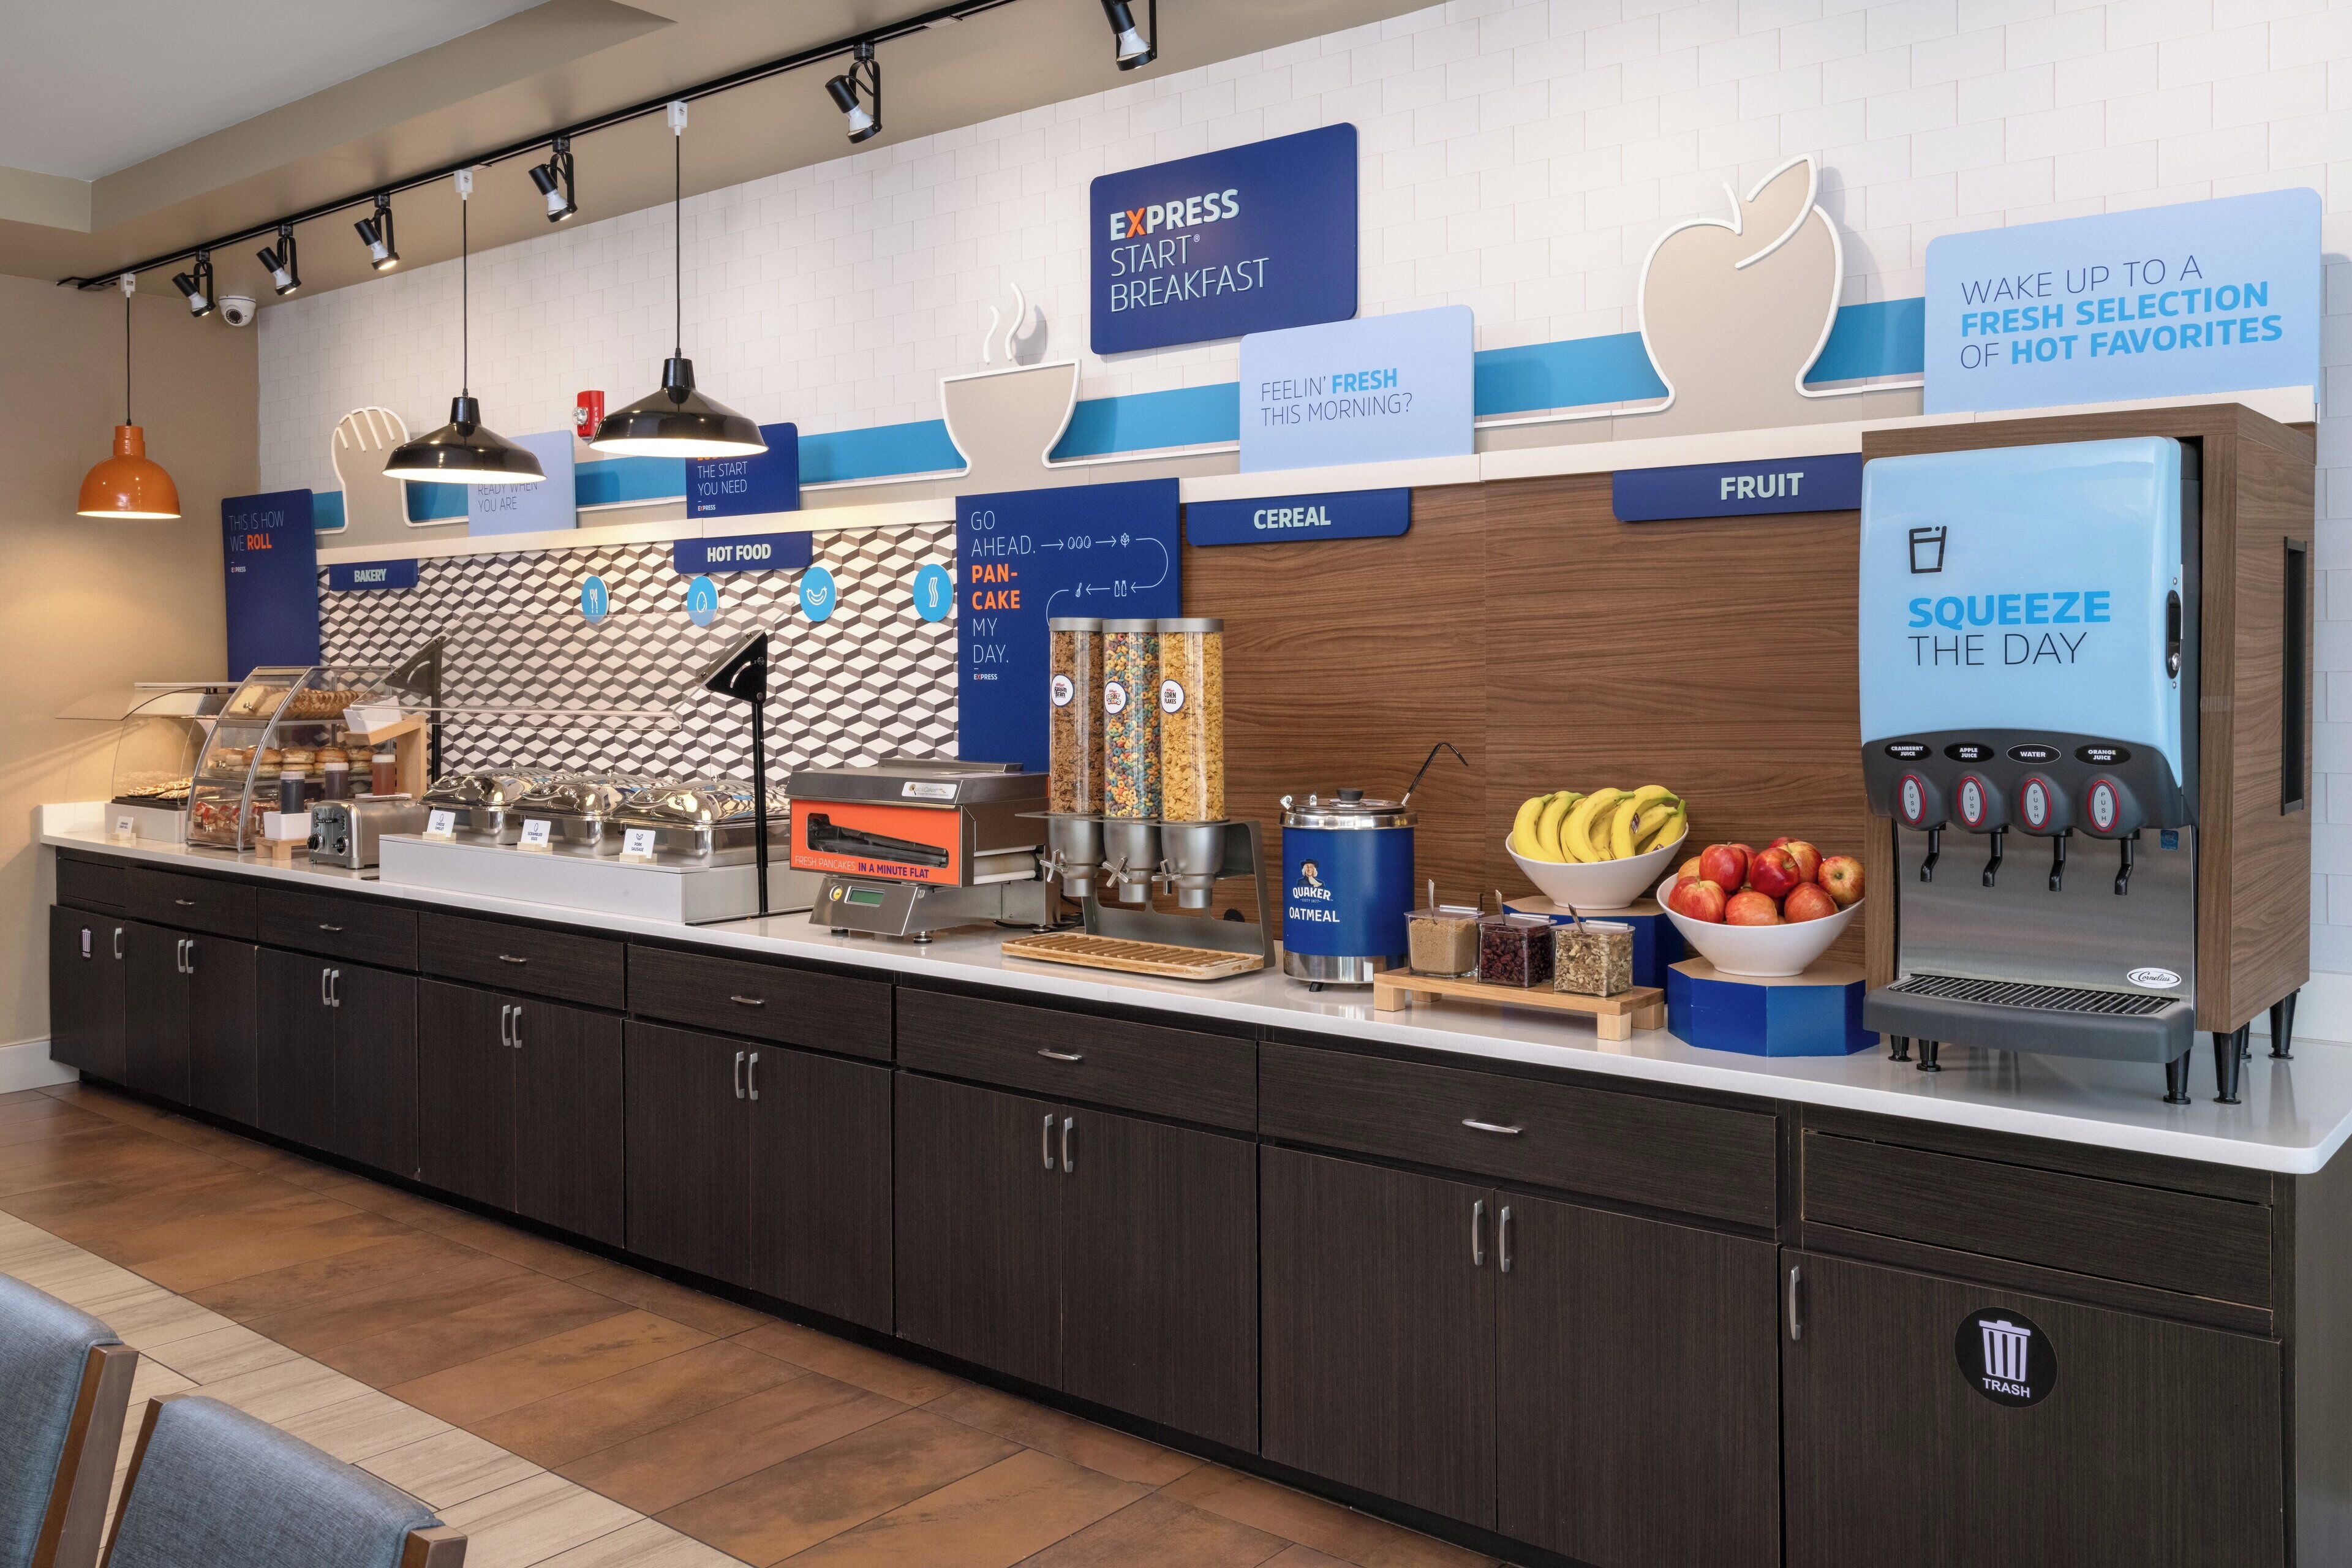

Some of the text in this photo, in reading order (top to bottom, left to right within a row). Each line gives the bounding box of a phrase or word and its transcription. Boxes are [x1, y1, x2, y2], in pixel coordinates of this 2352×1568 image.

[1110, 189, 1240, 241] EXPRESS
[1111, 257, 1270, 313] BREAKFAST
[1961, 255, 2203, 305] WAKE UP TO A
[1962, 281, 2267, 337] FRESH SELECTION
[1961, 314, 2283, 369] OF HOT FAVORITES
[1332, 368, 1397, 394] FRESH
[1261, 392, 1412, 427] THIS MORNING?
[697, 461, 748, 479] THE START
[478, 483, 507, 496] READY
[698, 479, 747, 496] YOU NEED
[1721, 472, 1804, 500] FRUIT
[478, 496, 518, 513] YOU ARE
[229, 510, 284, 531] THIS IS HOW
[971, 510, 995, 530] GO
[1253, 506, 1332, 529] CEREAL
[230, 533, 273, 552] WE ROLL
[707, 543, 772, 562] HOT FOOD
[971, 535, 1036, 557] AHEAD.
[354, 568, 387, 582] BAKERY
[971, 563, 1018, 584] PAN-
[971, 590, 1020, 610] CAKE
[1908, 590, 2111, 630] SQUEEZE
[973, 617, 998, 637] MY
[973, 644, 1009, 663] DAY.
[1908, 631, 2088, 666] THE DAY
[795, 855, 930, 878] FRESH PANCAKES IN A MINUTE FLAT
[1292, 887, 1331, 901] QUAKER
[1289, 907, 1340, 922] OATMEAL
[2138, 971, 2170, 982] Cornelius
[1982, 1378, 2030, 1398] TRASH
